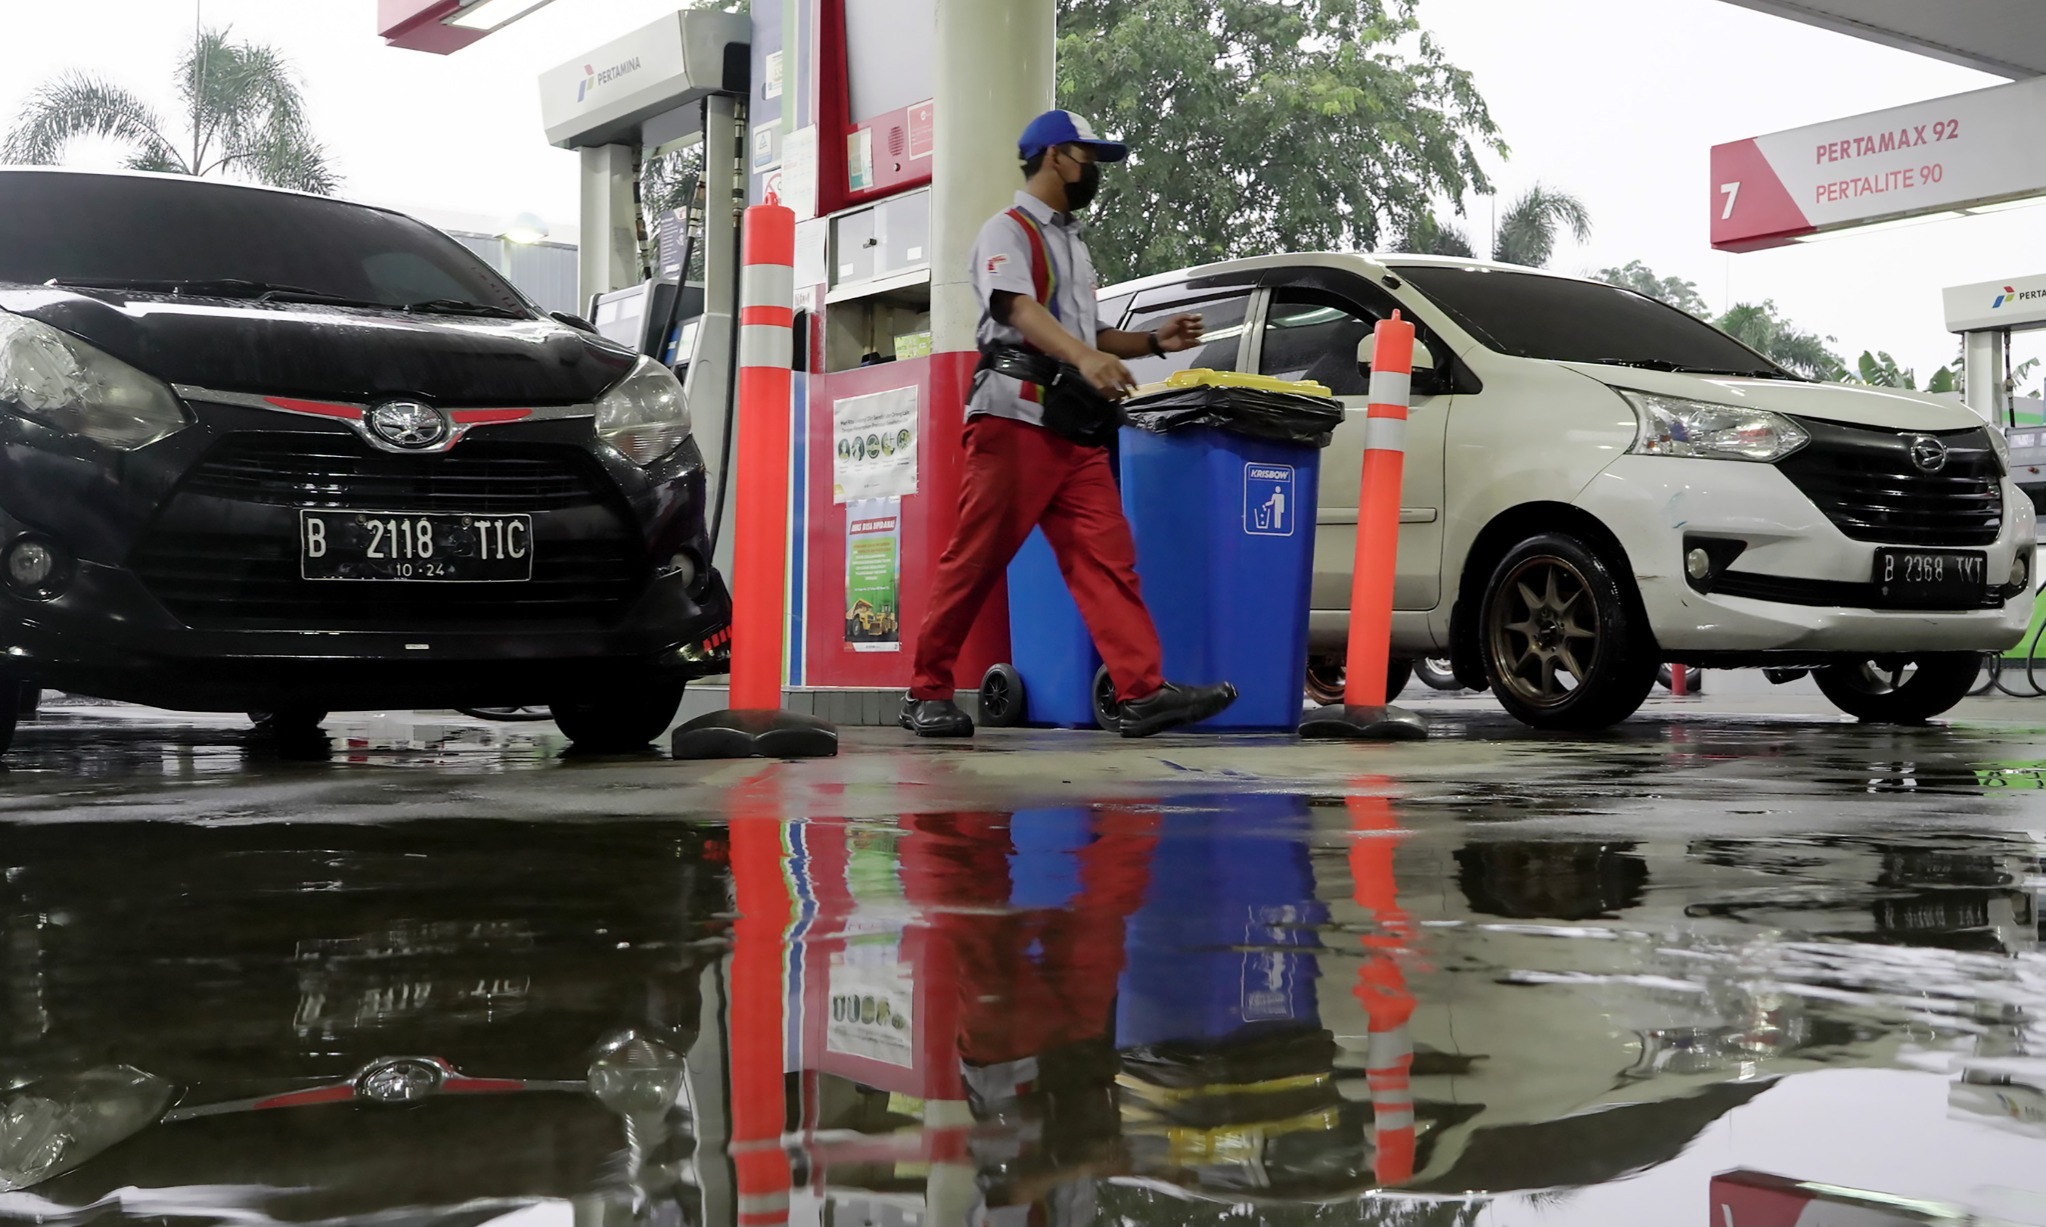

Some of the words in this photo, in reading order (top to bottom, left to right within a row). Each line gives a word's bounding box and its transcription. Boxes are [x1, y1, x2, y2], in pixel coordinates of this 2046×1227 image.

[597, 56, 641, 85] PERTAMINA
[1816, 124, 1927, 164] PERTAMAX
[1933, 118, 1959, 142] 92
[1720, 181, 1741, 220] 7
[1816, 168, 1914, 204] PERTALITE
[1919, 163, 1943, 185] 90
[1250, 469, 1289, 480] KRISBOW
[307, 518, 327, 558] B
[366, 518, 434, 559] 2118
[474, 519, 526, 560] TIC
[1885, 554, 1894, 582] B
[1904, 555, 1943, 582] 2368
